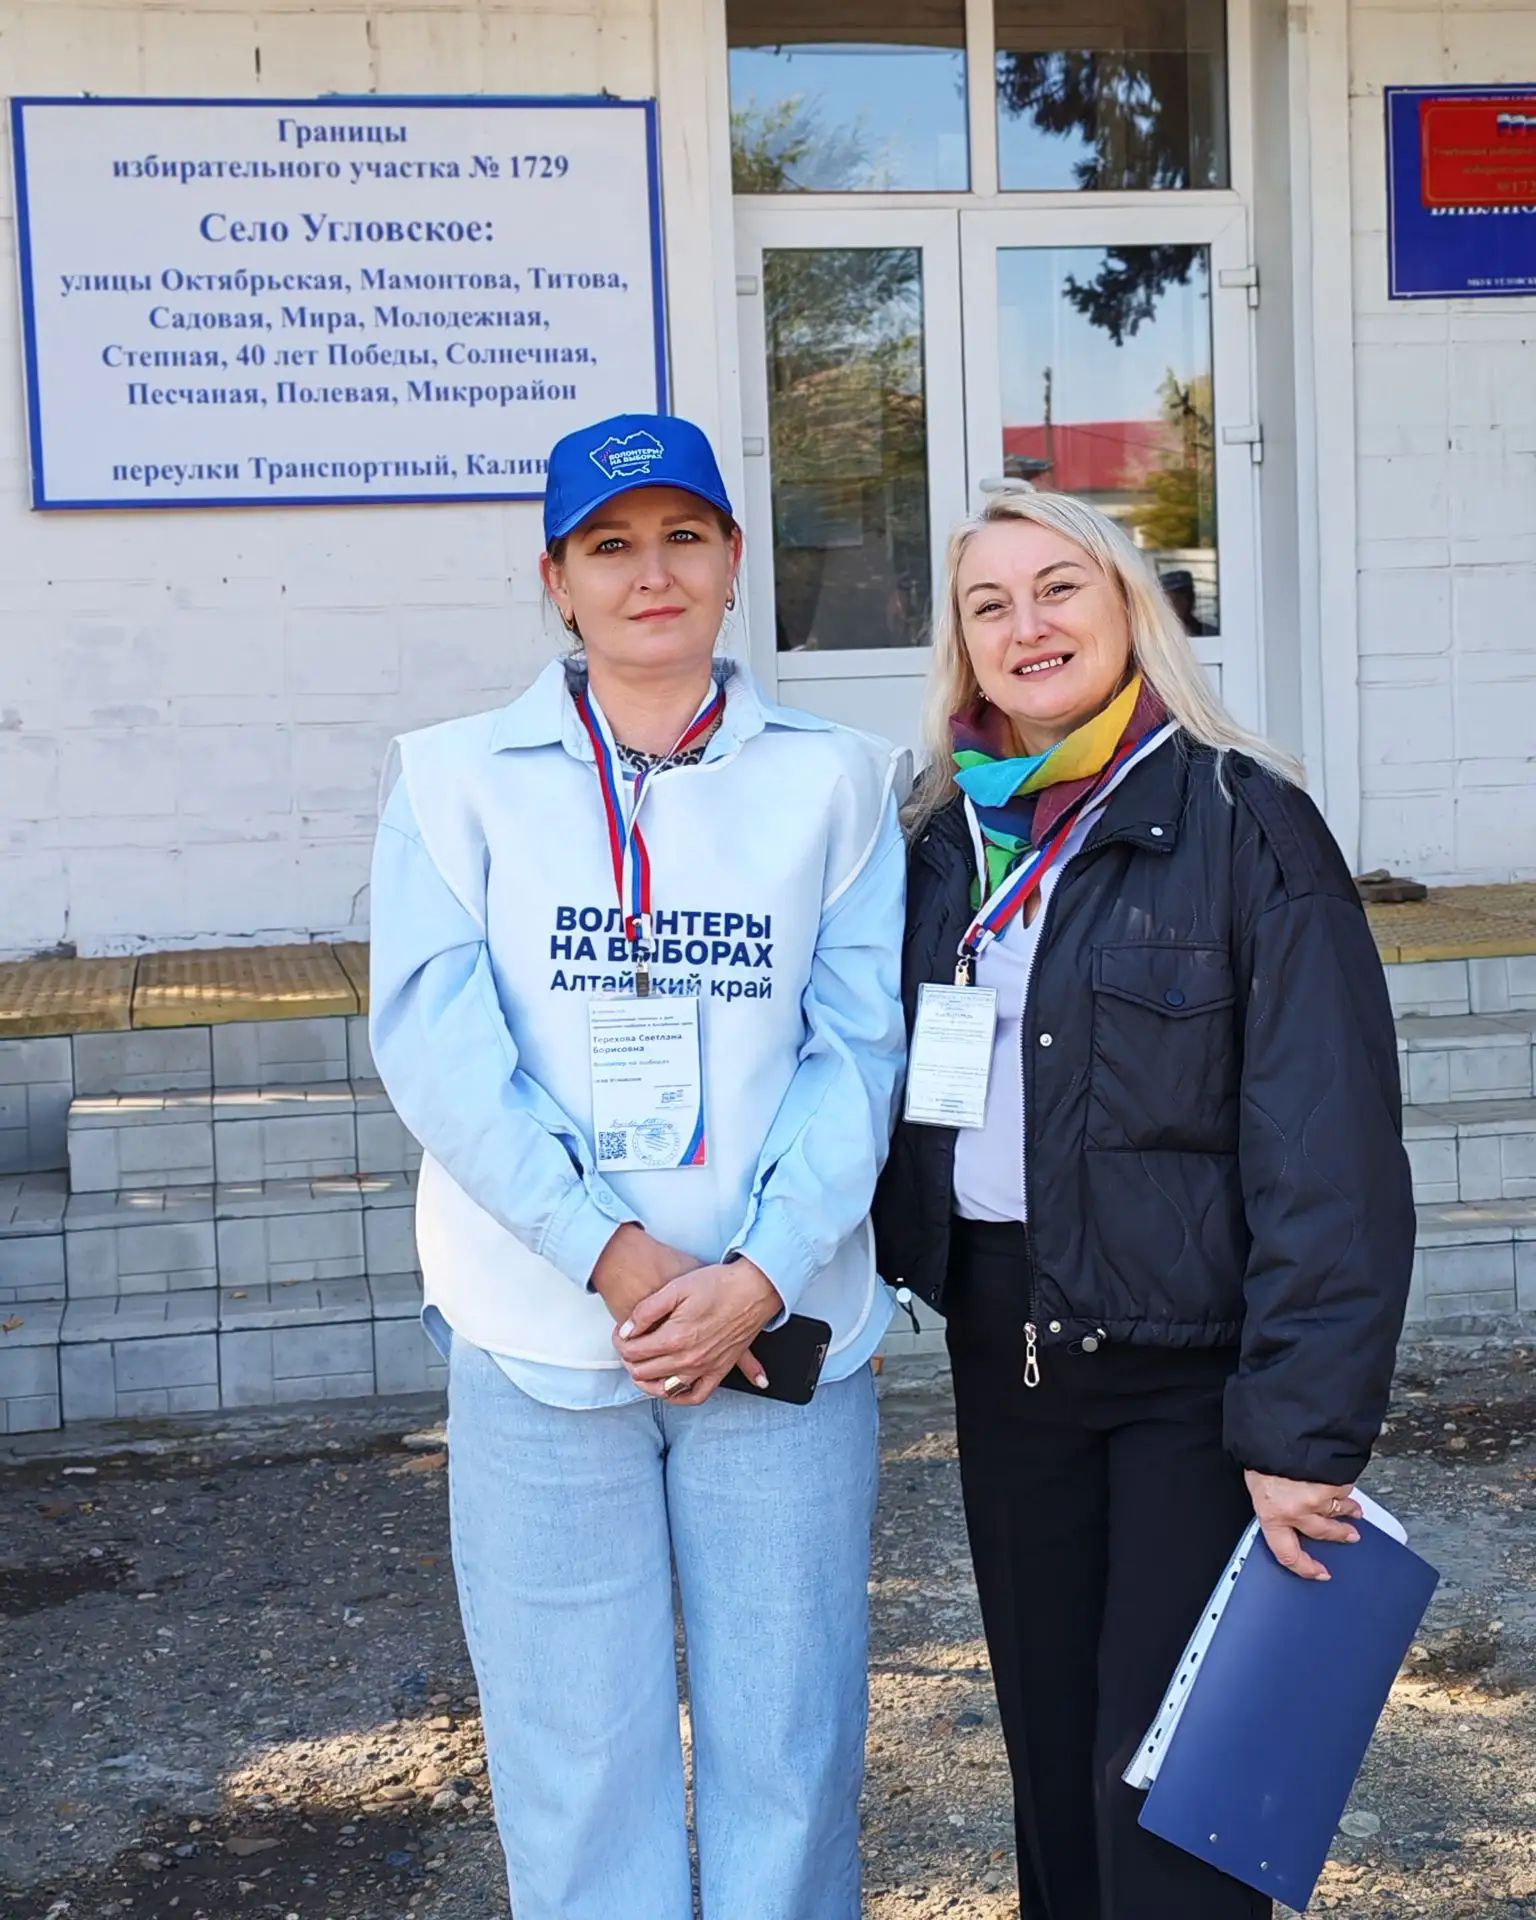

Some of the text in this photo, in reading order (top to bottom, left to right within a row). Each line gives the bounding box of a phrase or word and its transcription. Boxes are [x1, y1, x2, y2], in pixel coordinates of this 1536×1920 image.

[279, 119, 407, 149] Границы
[112, 156, 569, 184] избирательного участка № 1729
[200, 212, 494, 243] Село Угловское:
[60, 268, 628, 297] улицы Октябрьская, Мамонтова, Титова,
[149, 305, 550, 333] Садовая, Мира, Молодежная,
[102, 343, 597, 370] Степная, 40 лет Победы, Солнечная,
[128, 379, 577, 408] Песчаная, Полевая, Микрорайон
[112, 454, 547, 486] переулки Транспортный, Калин
[555, 906, 771, 939] ВОЛНТЕРЫ
[550, 935, 598, 961] НА
[550, 969, 772, 1003] Алтайкий край
